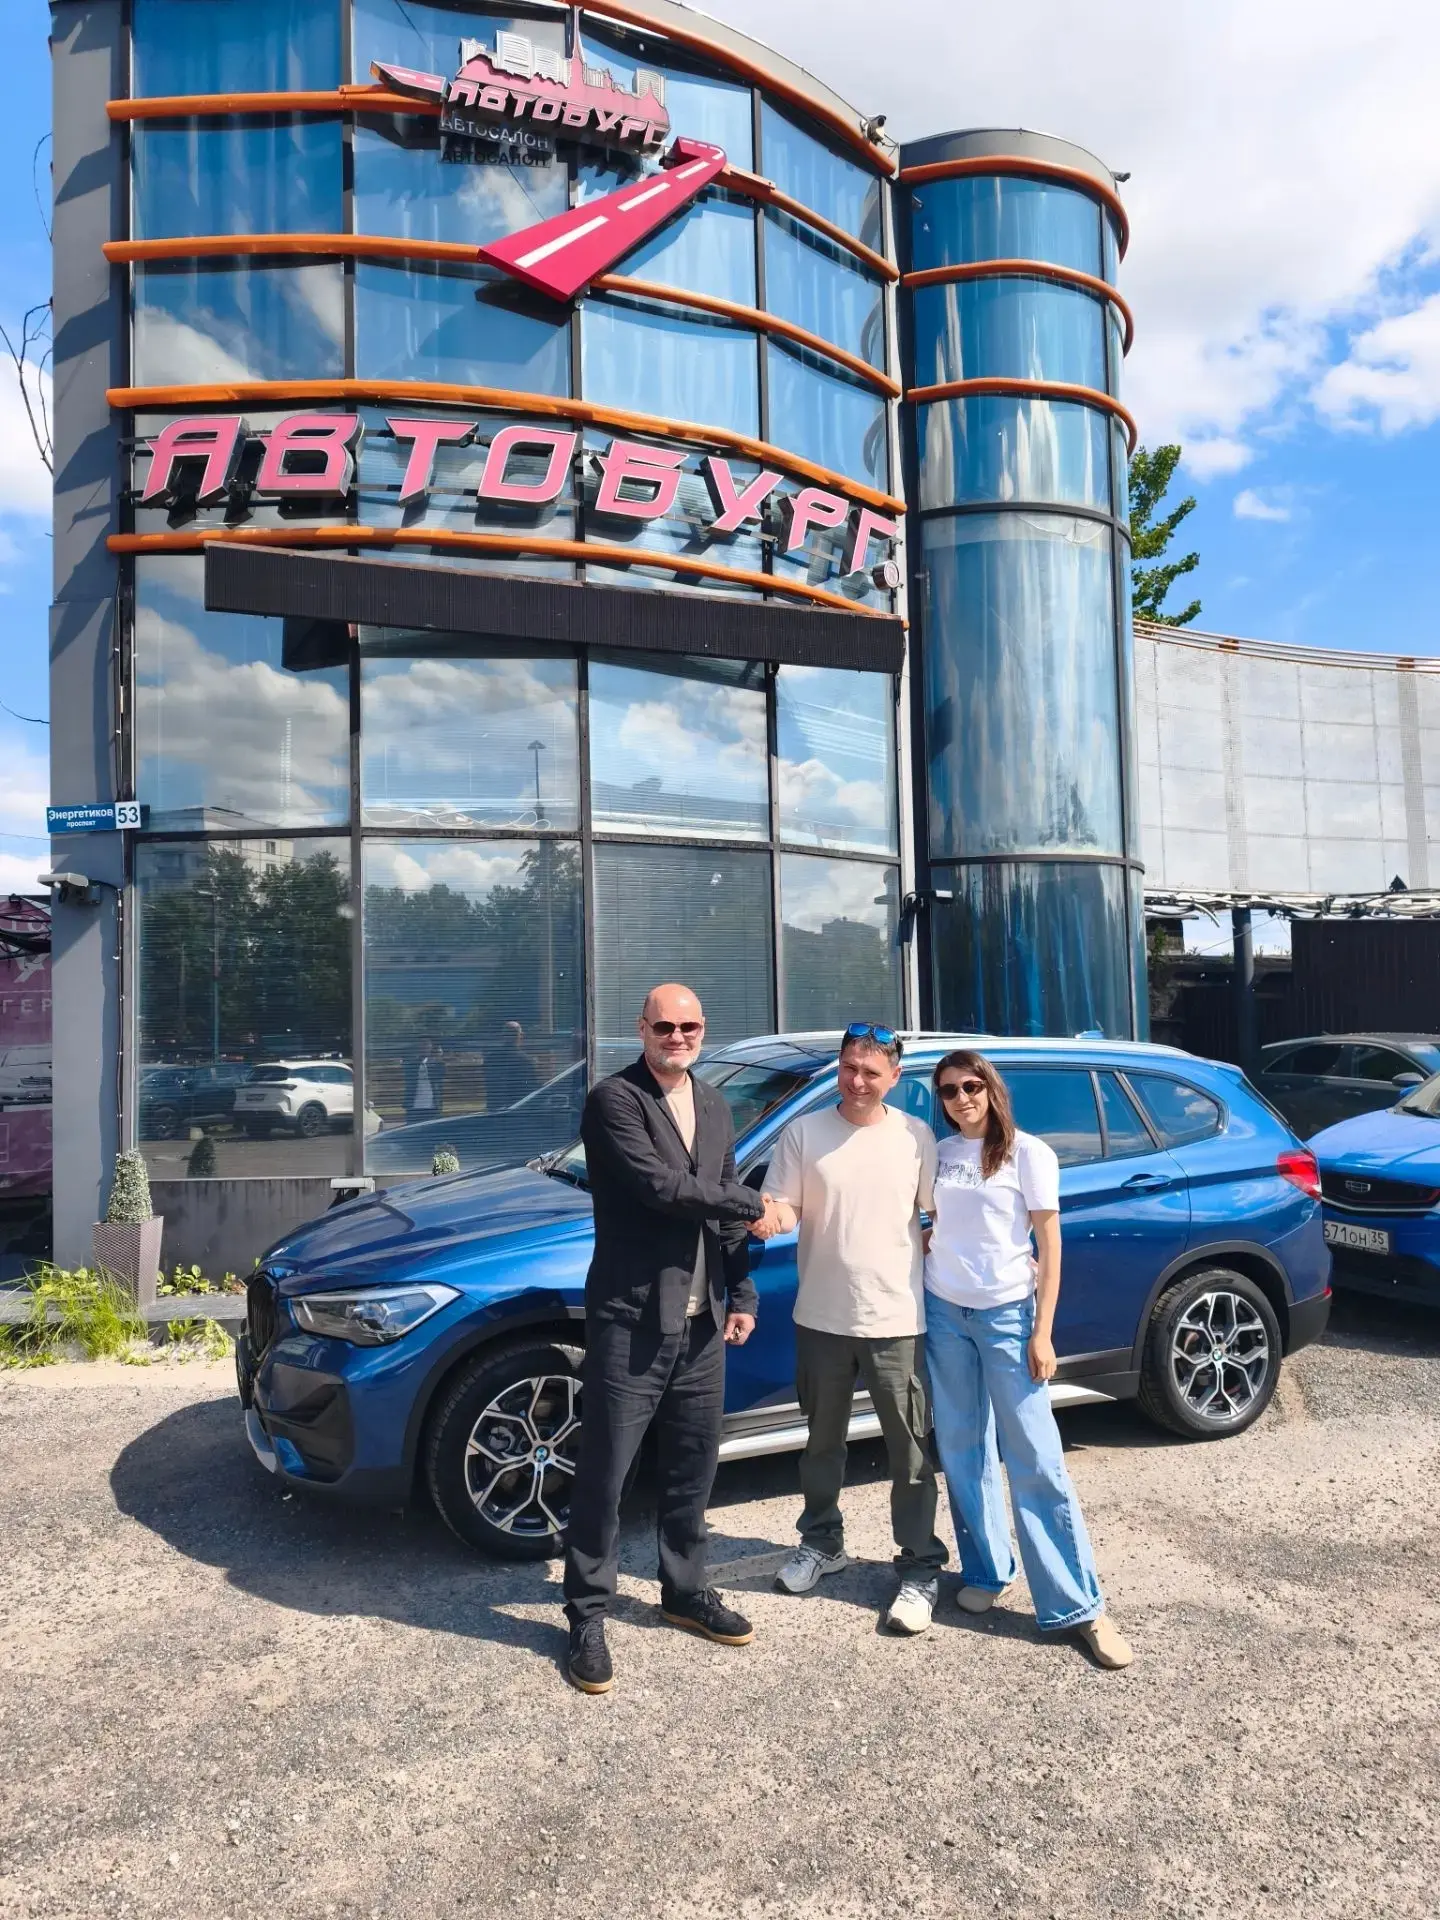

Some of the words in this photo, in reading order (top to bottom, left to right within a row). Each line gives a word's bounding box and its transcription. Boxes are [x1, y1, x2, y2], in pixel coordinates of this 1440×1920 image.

[447, 79, 670, 146] АВТОБУРГ
[441, 117, 549, 149] АВТОСАЛОН
[140, 412, 900, 578] АВТОБУРГ
[48, 808, 114, 821] Энергетиков
[118, 806, 139, 824] 53
[66, 820, 96, 828] проспект
[1371, 1231, 1385, 1245] 35
